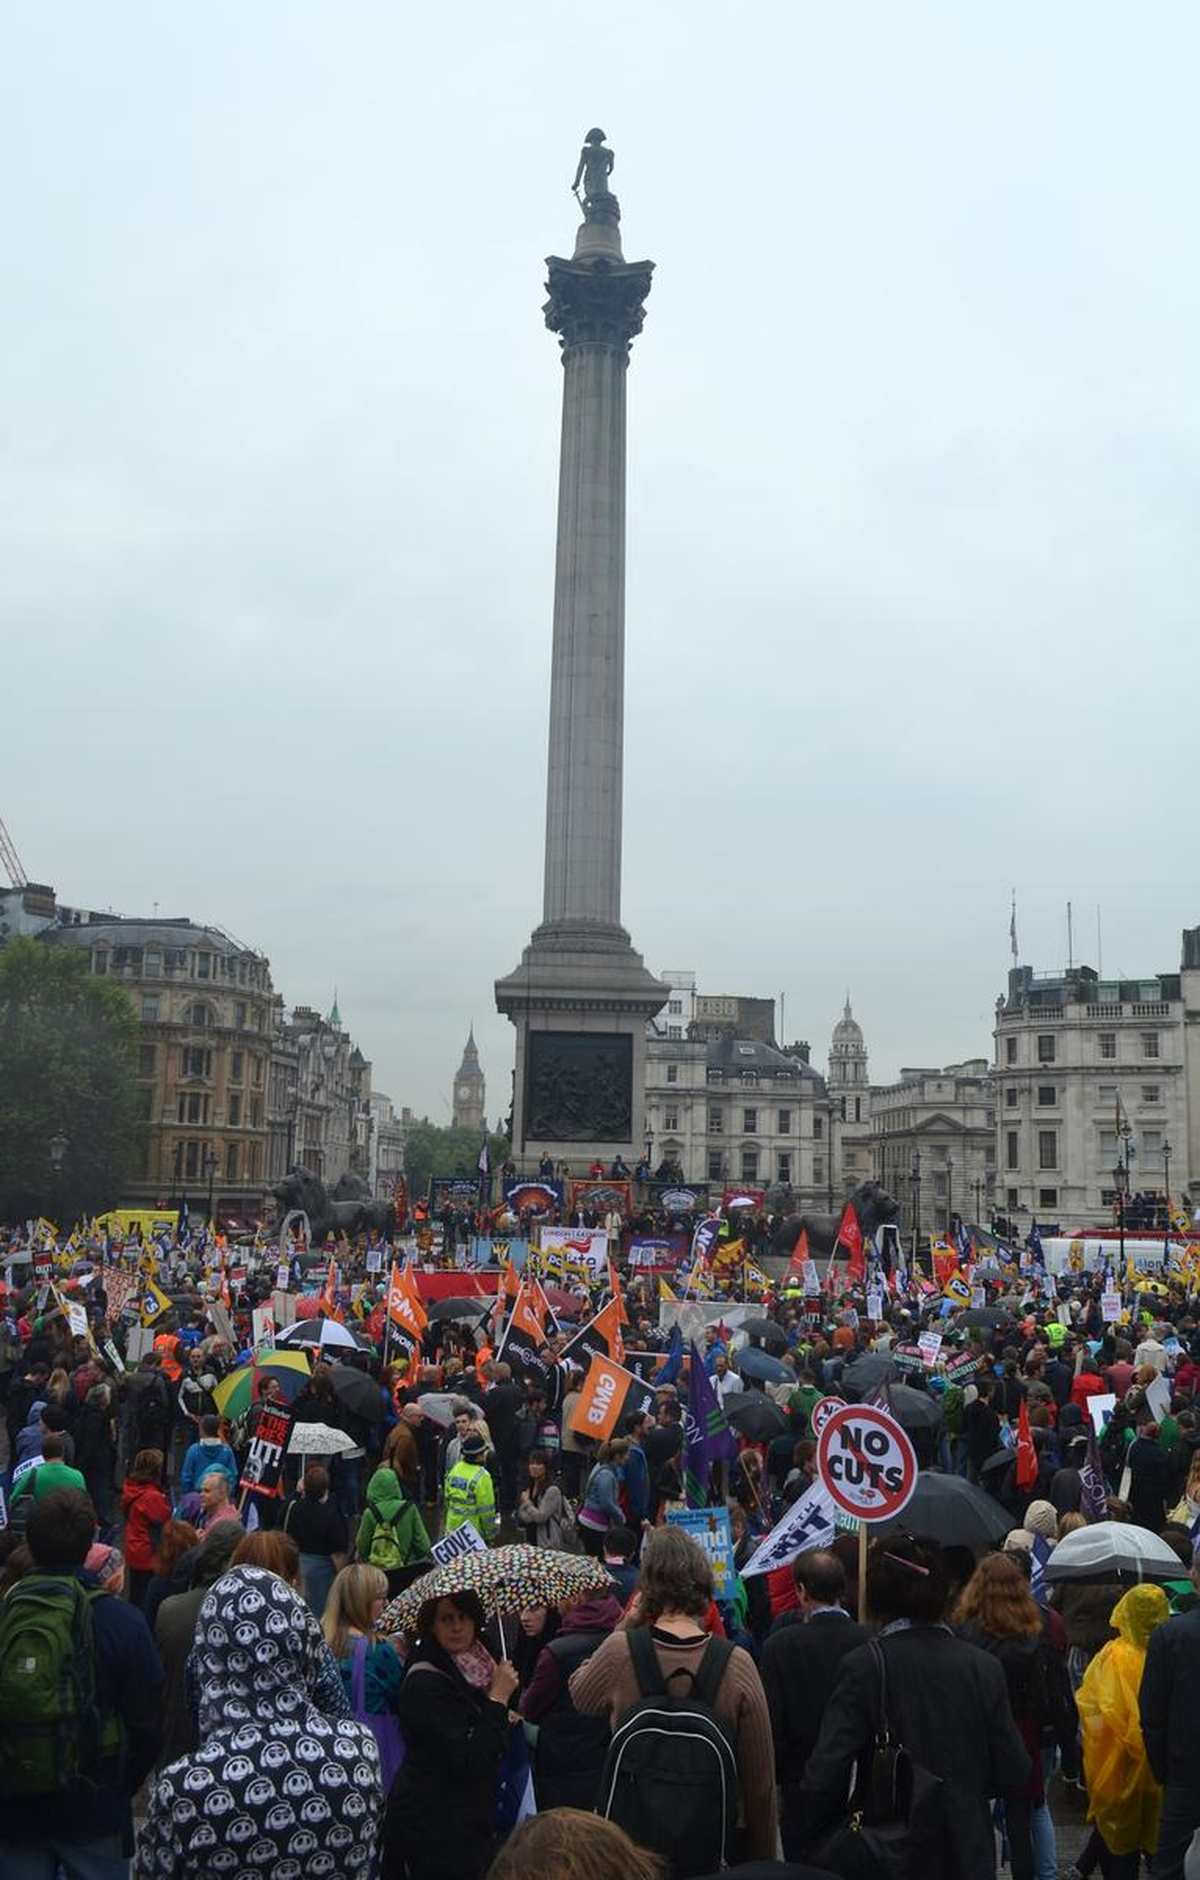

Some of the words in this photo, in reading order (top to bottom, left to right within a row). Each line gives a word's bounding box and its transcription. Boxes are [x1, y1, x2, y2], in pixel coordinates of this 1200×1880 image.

[587, 1373, 617, 1424] GMB
[249, 1437, 283, 1467] UT!
[841, 1424, 890, 1456] NO
[828, 1454, 903, 1494] CUTS
[434, 1525, 477, 1564] GOVE
